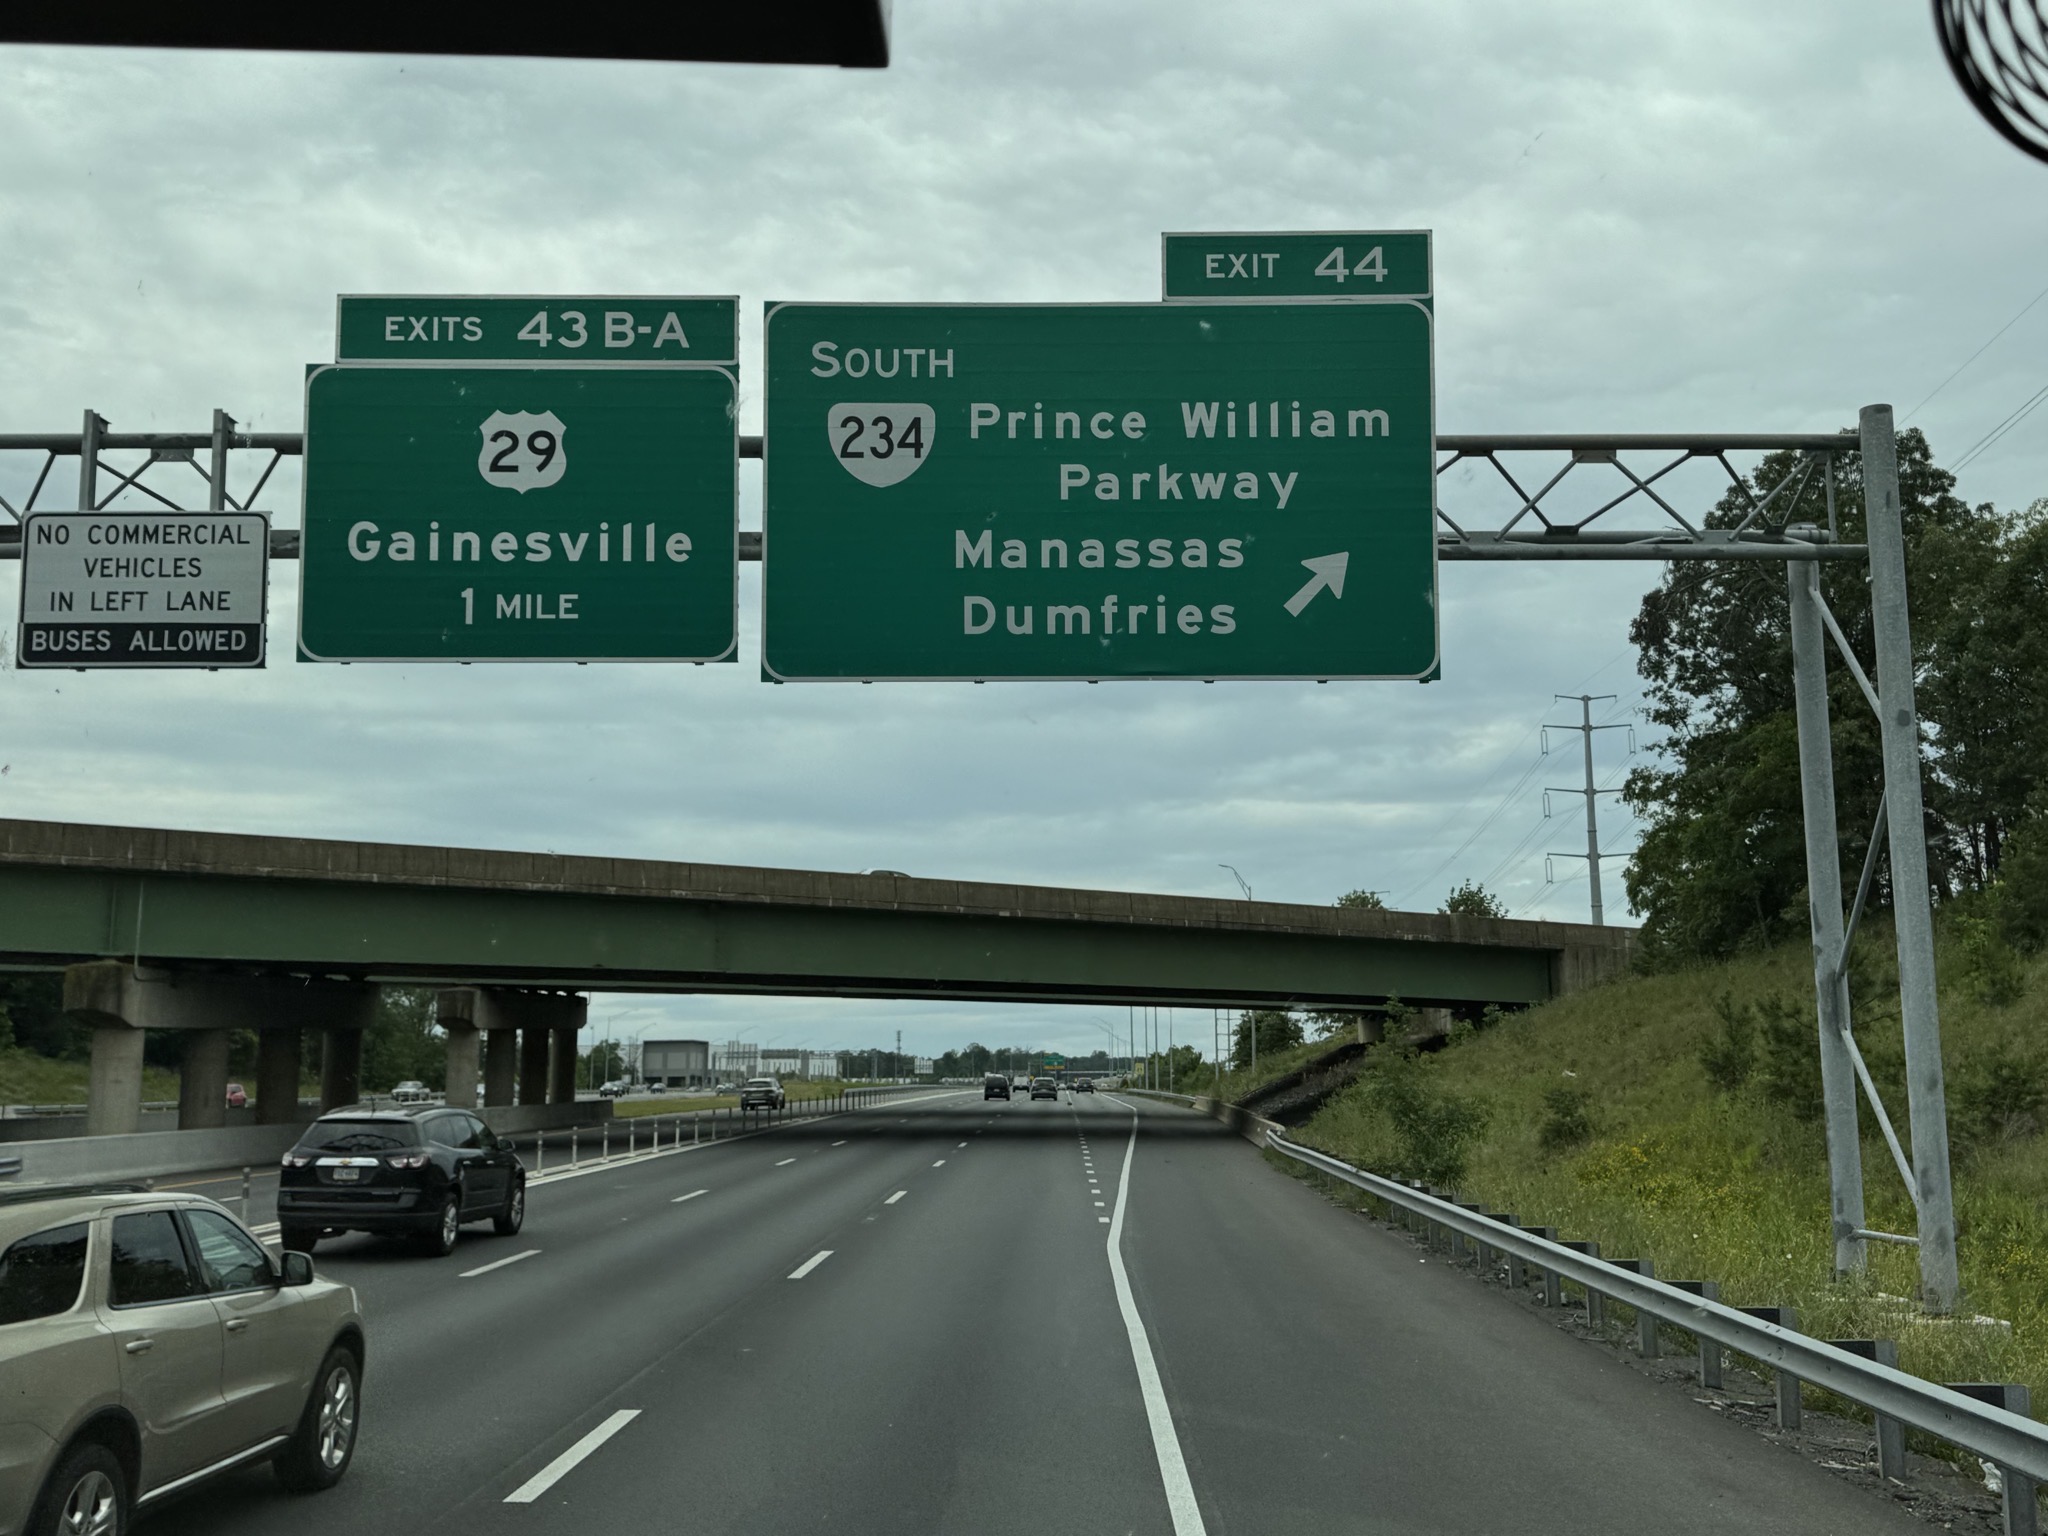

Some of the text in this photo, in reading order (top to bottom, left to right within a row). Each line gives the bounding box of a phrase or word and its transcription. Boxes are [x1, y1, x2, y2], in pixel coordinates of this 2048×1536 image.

[1205, 246, 1389, 283] EXIT 44
[385, 311, 690, 348] EXITS 43 B-A
[810, 341, 954, 378] SOUTH
[839, 416, 924, 459] 234
[970, 401, 1391, 439] Prince William
[489, 430, 557, 473] 29
[1060, 463, 1298, 510] Parkway
[37, 524, 250, 545] NO COMMERCIAL
[347, 521, 692, 562] Gainesville
[955, 529, 1245, 569] Manassas
[84, 557, 202, 578] VEHICLES
[50, 591, 231, 611] IN LEFT LANE
[461, 587, 579, 624] 1 MILE
[964, 596, 1237, 635] Dumfries
[31, 630, 247, 651] BUSES ALLOWED
